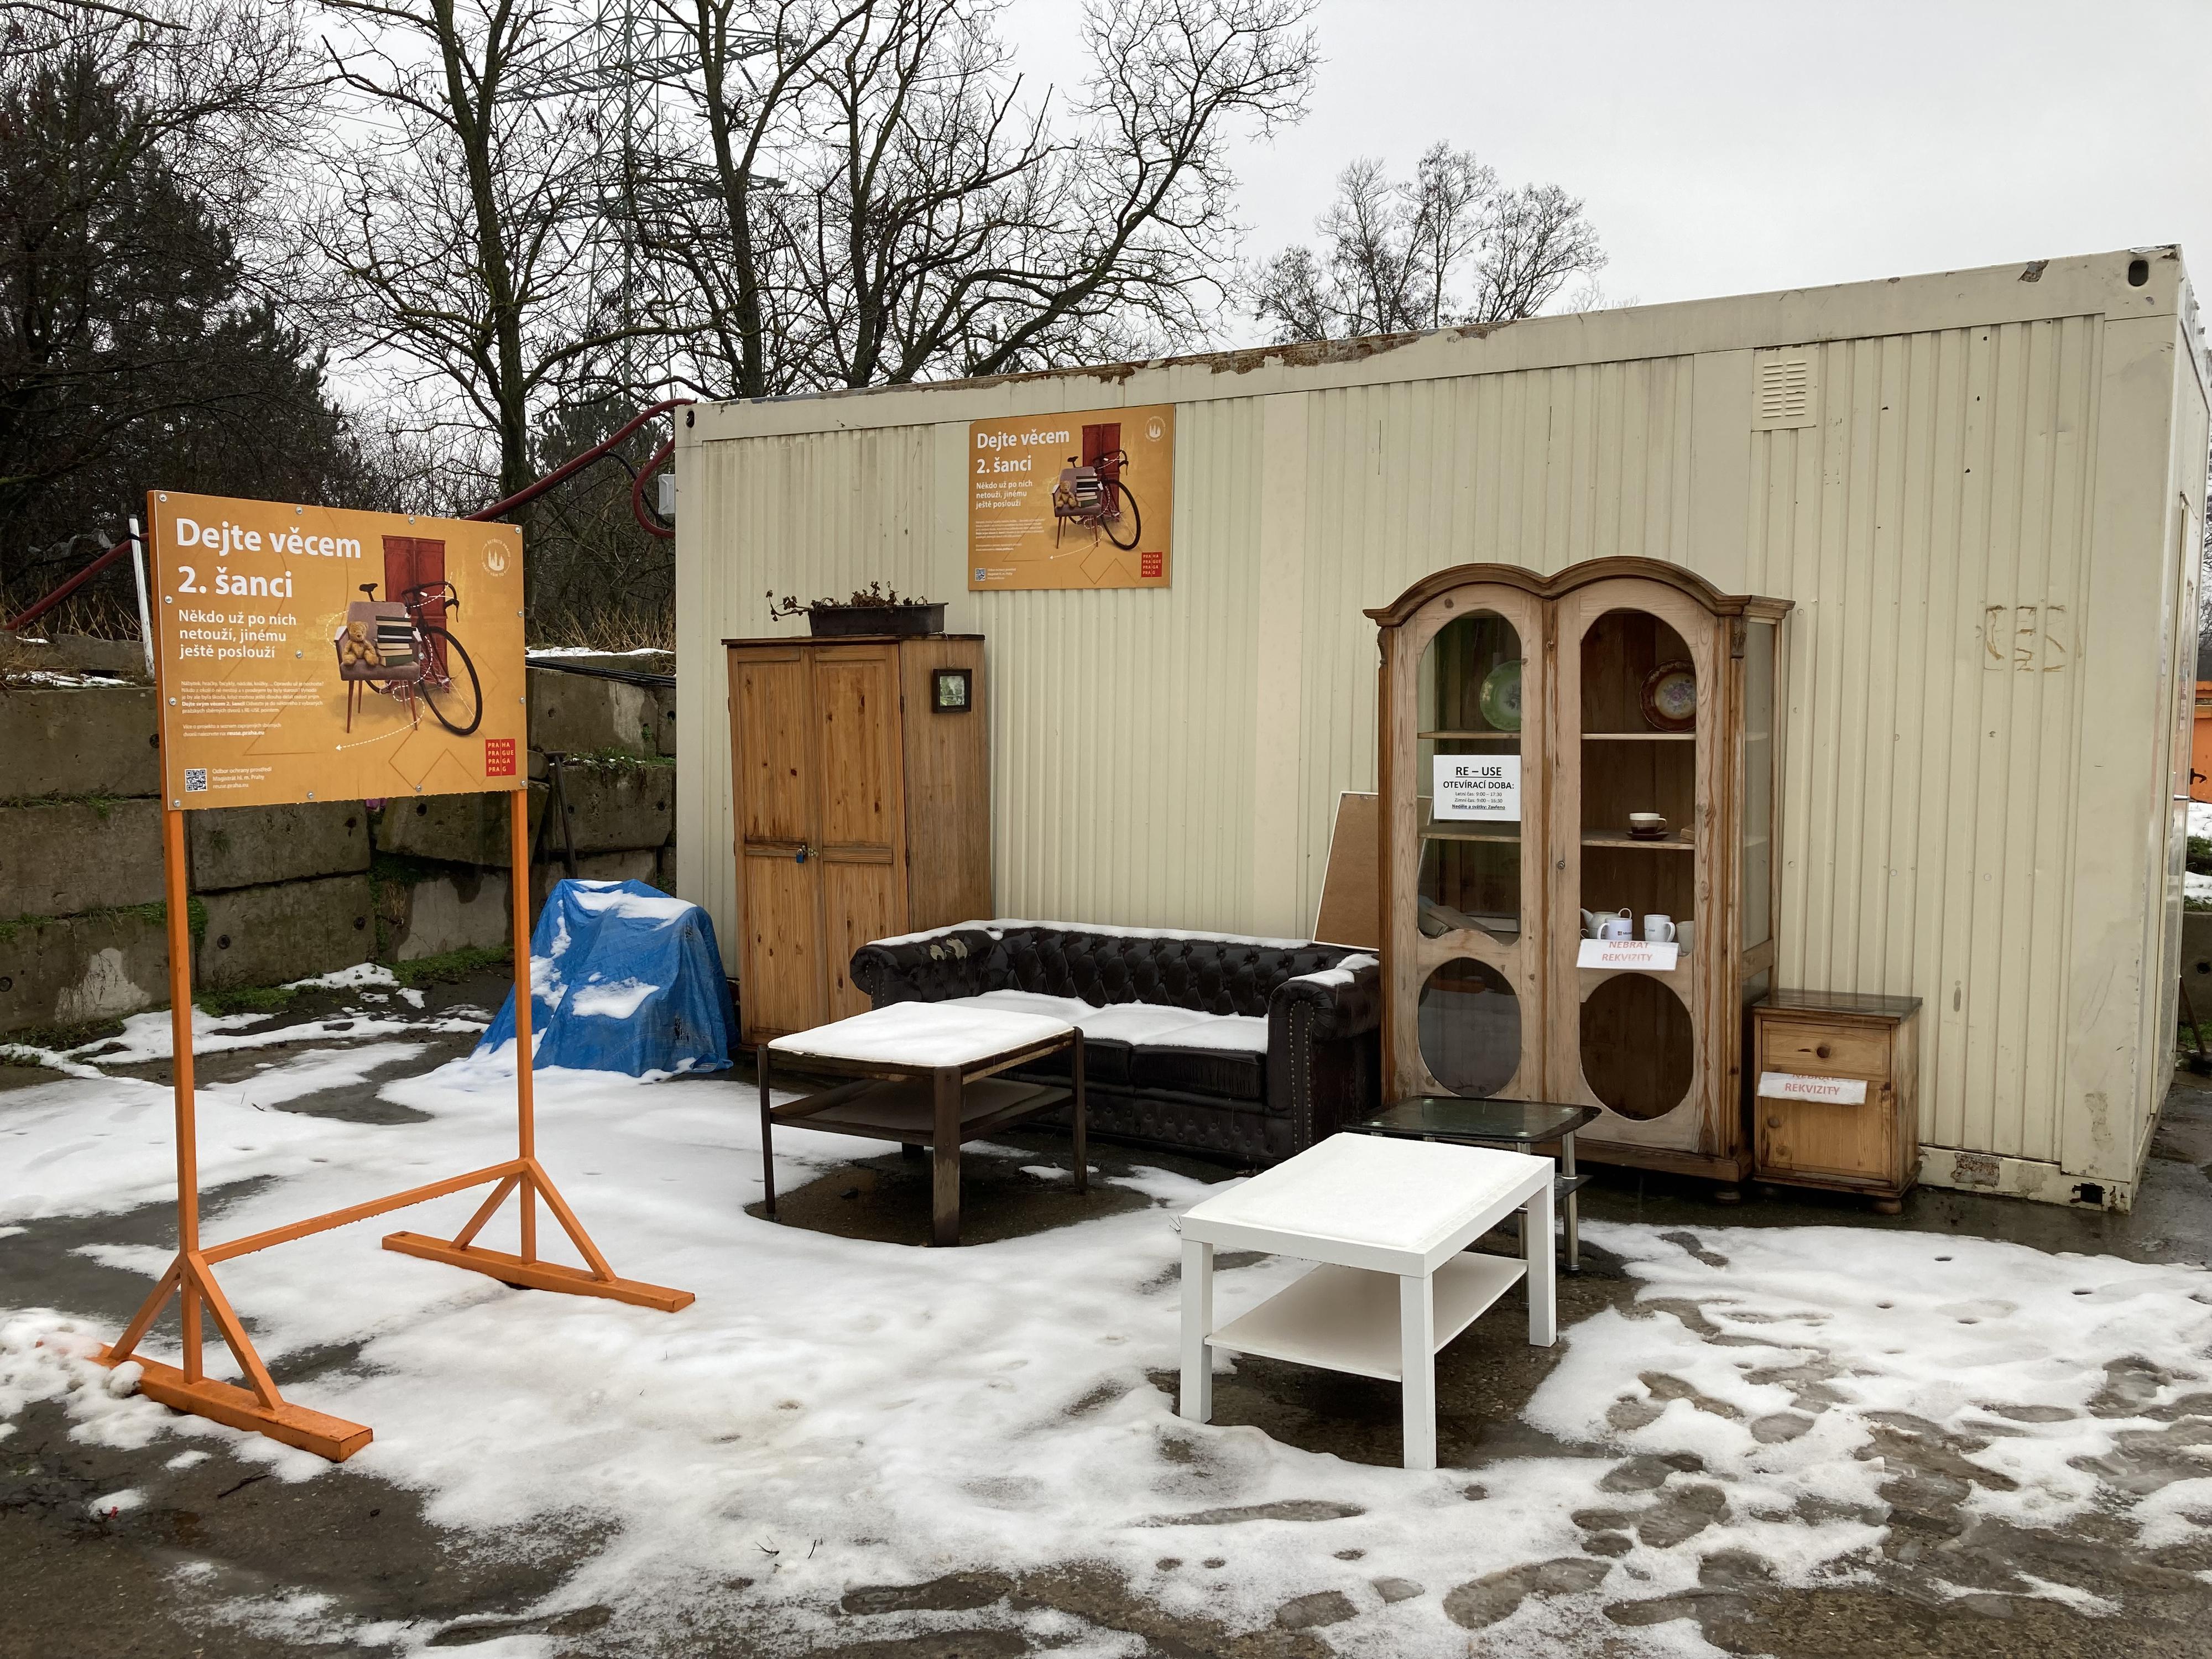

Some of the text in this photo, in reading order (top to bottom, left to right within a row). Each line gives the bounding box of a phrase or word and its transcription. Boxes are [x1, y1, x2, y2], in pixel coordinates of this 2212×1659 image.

[977, 429, 1069, 451] Dejte věcem
[977, 455, 1032, 474] 2. šanci
[976, 481, 997, 489] Někdo
[176, 518, 361, 559] Dejte věcem
[178, 566, 292, 598] 2. šanci
[179, 609, 296, 627] Někdo už po nich
[179, 628, 286, 644] netouží, jinému
[179, 644, 275, 660] ještě poslouží
[1455, 766, 1469, 776] RE
[1481, 766, 1502, 776] USE
[1443, 780, 1486, 789] OTEVÍRACÍ
[1601, 953, 1653, 962] REKVIZITY
[1785, 1083, 1840, 1095] REKVIZITY
